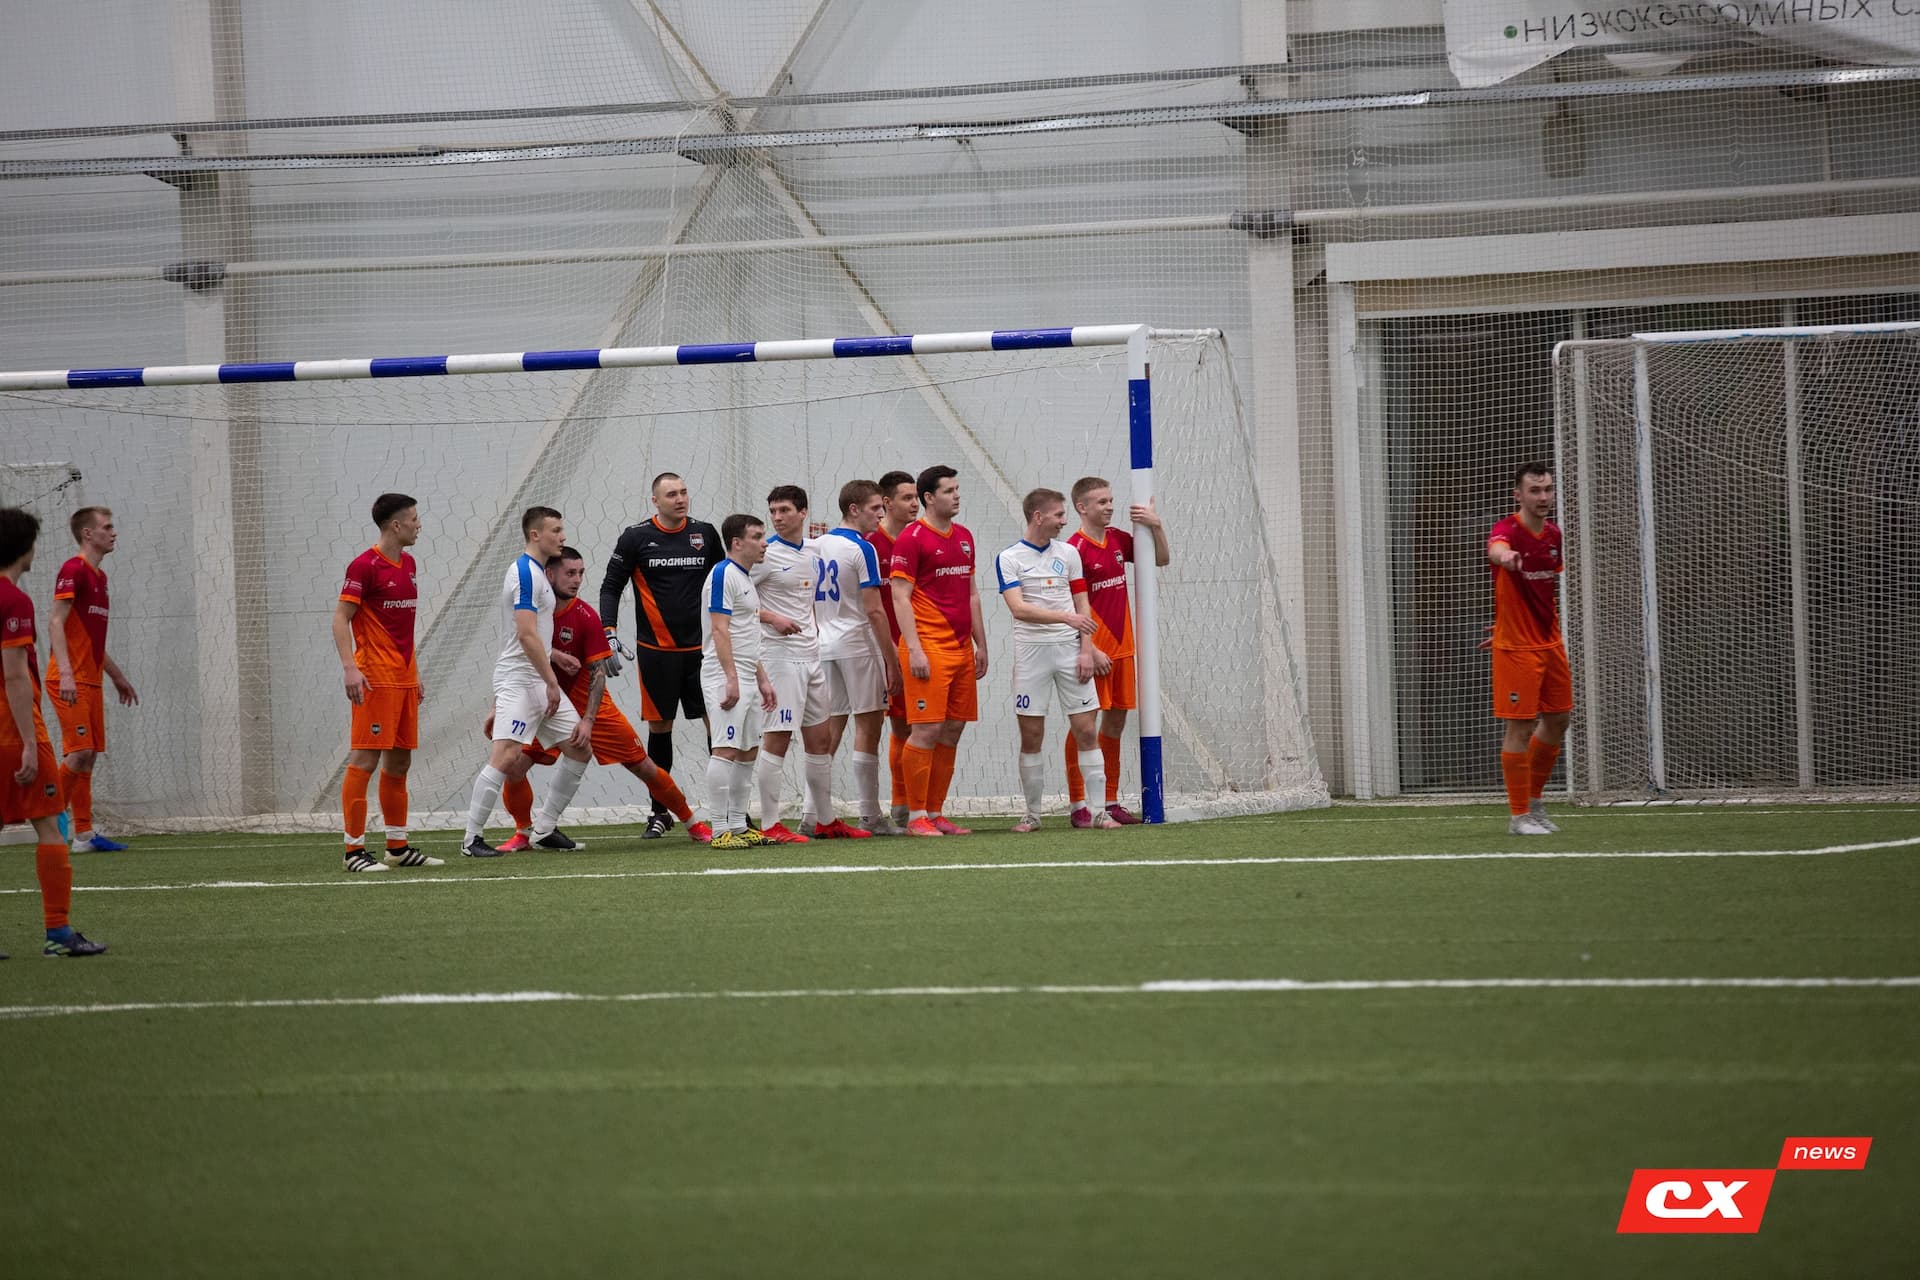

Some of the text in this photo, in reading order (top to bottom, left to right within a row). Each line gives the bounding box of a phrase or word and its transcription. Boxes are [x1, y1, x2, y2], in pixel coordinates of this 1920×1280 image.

[648, 557, 706, 568] ПРОДИНВЕСТ
[815, 558, 840, 602] 23
[1016, 694, 1030, 709] 20
[780, 709, 792, 723] 14
[511, 719, 526, 736] 77
[727, 725, 735, 740] 9
